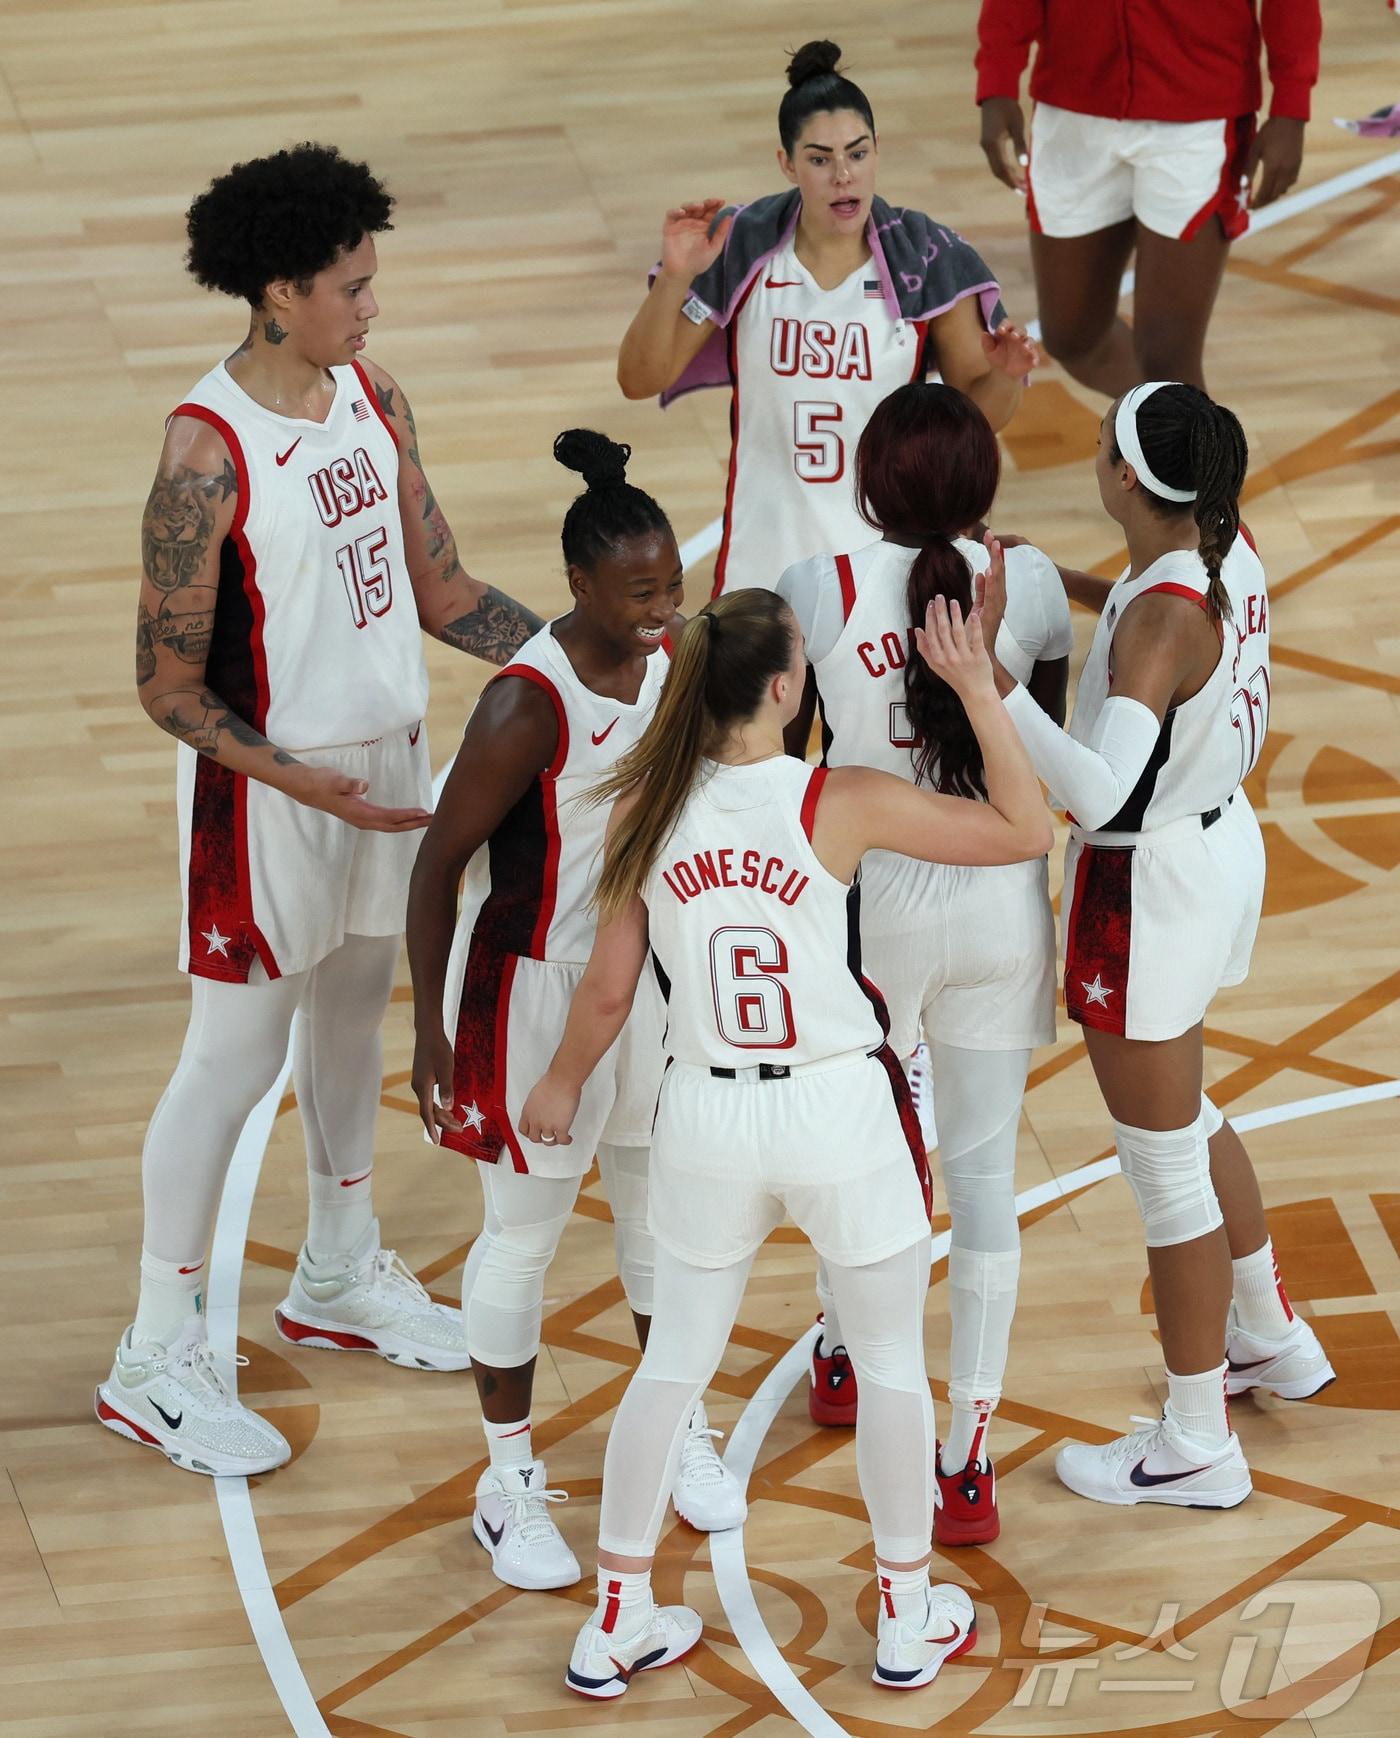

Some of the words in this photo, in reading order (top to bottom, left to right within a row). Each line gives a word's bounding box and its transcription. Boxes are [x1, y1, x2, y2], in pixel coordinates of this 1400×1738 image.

[770, 318, 872, 380] USA
[794, 401, 844, 483] 5
[308, 448, 388, 528] USA
[336, 526, 393, 629] 15
[662, 848, 810, 906] IONESCU
[709, 925, 797, 1049] 6
